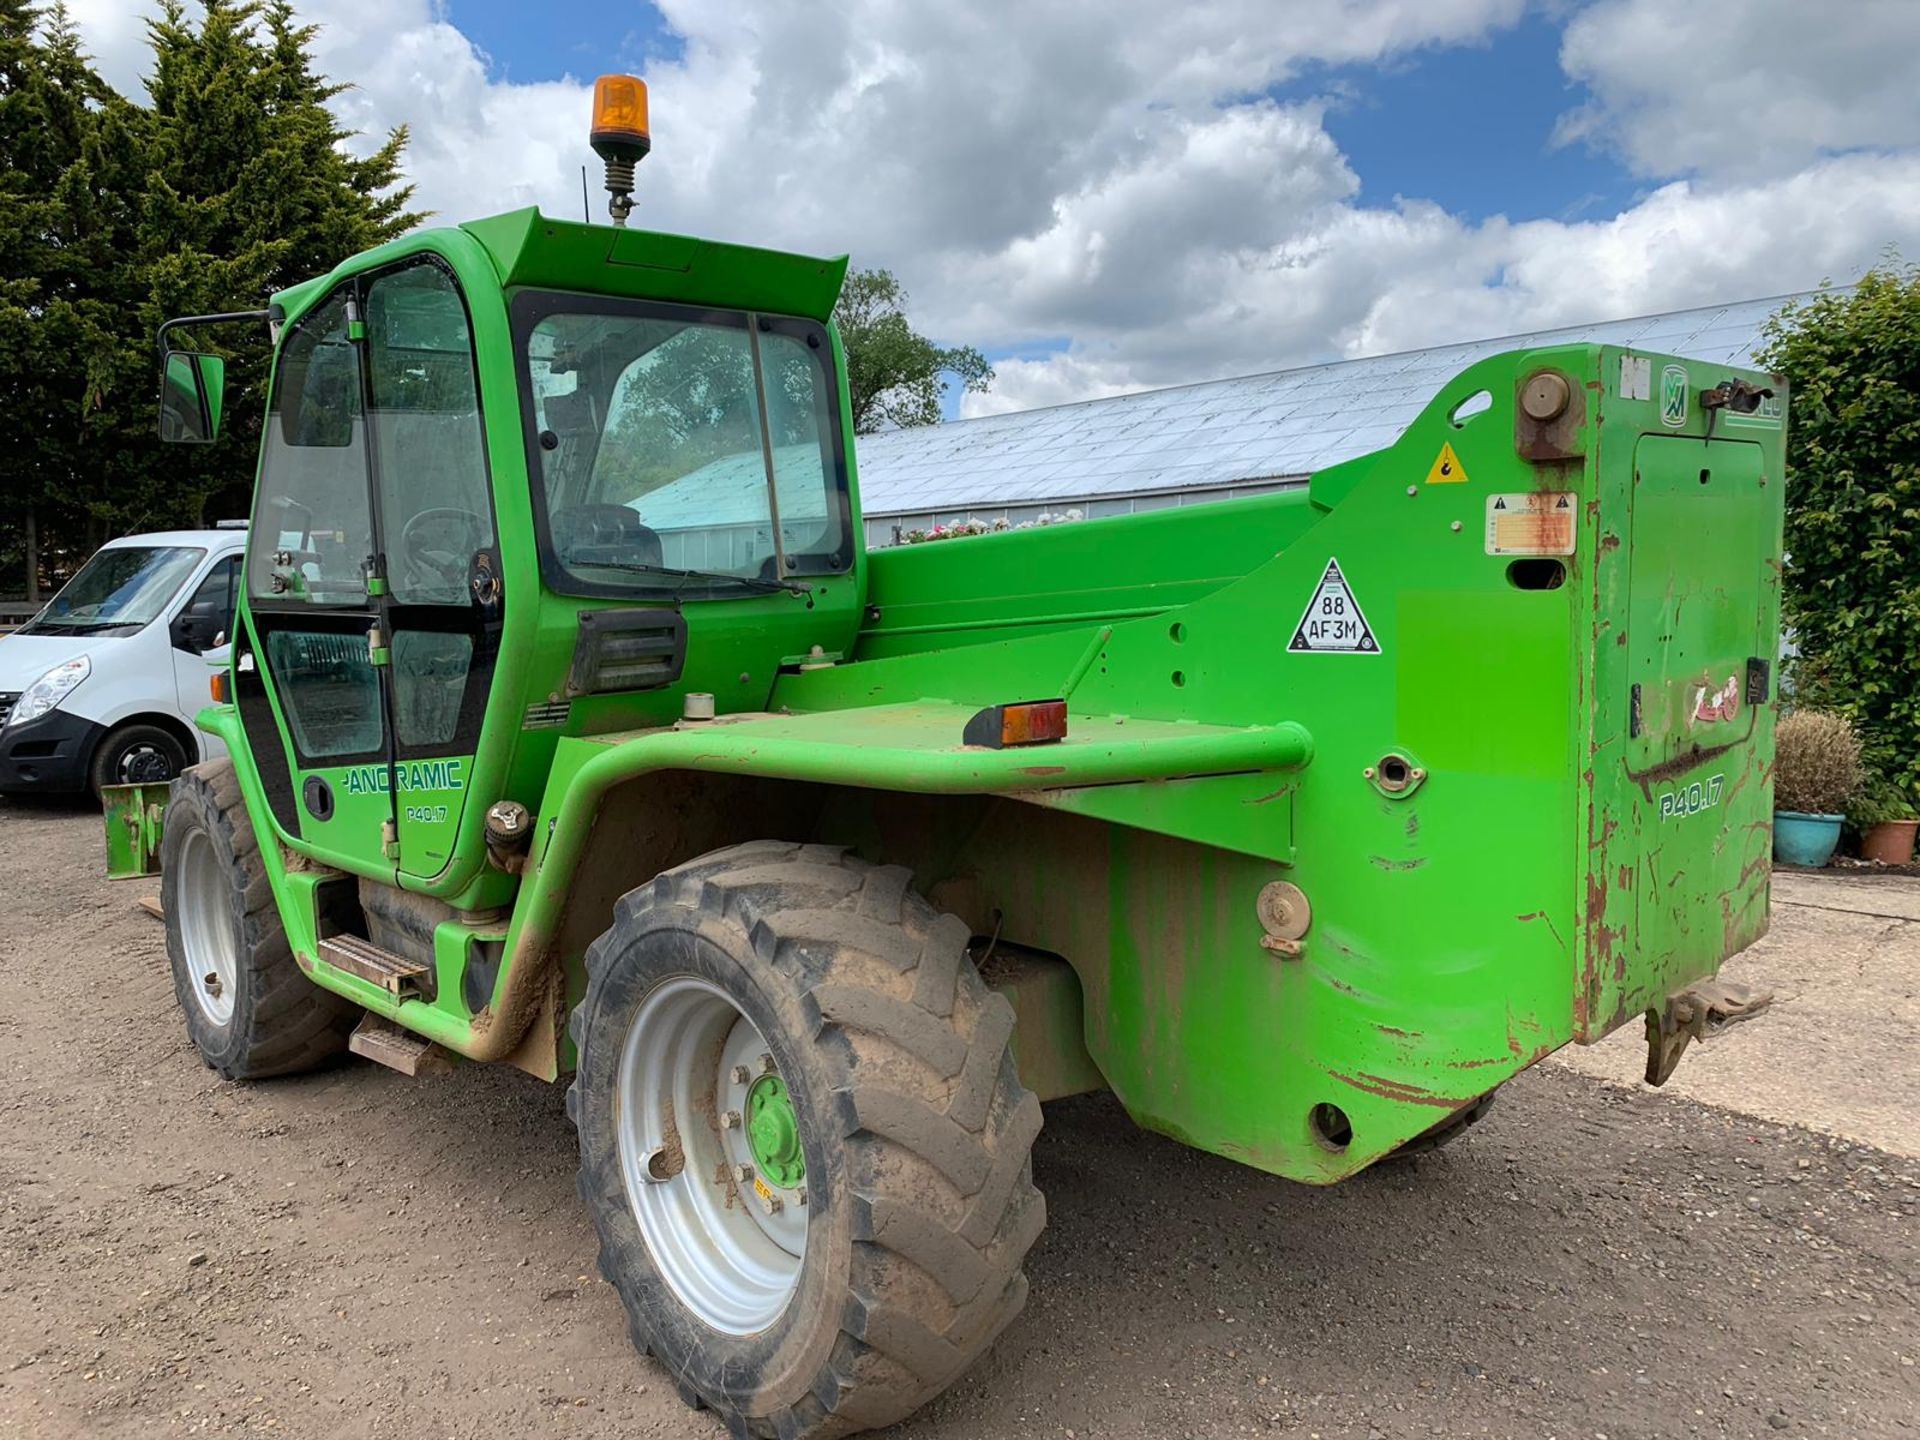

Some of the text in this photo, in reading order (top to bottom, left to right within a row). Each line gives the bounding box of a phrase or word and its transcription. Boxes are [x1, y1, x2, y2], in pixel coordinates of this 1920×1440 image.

[1322, 596, 1344, 616] 88
[1309, 620, 1357, 640] AF3M
[340, 761, 463, 795] ANORAMIC
[1659, 774, 1724, 823] P40.17
